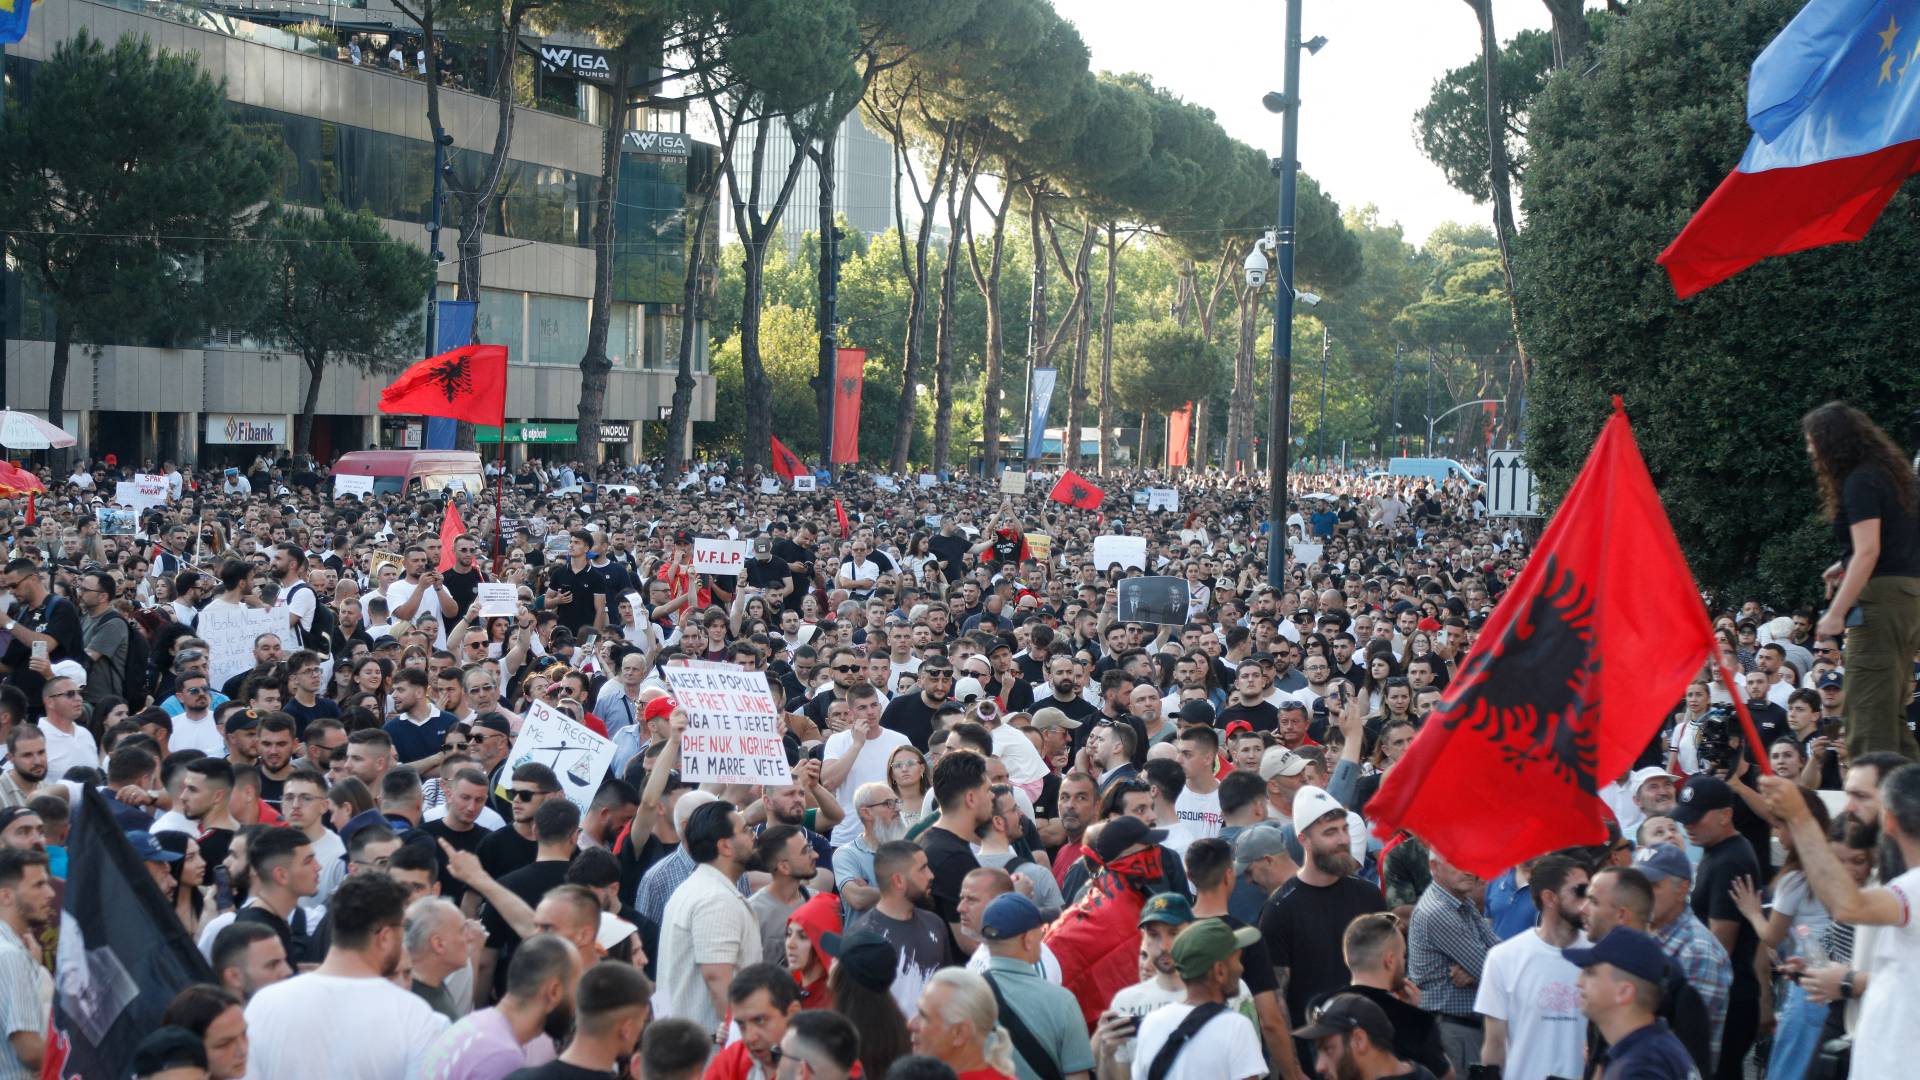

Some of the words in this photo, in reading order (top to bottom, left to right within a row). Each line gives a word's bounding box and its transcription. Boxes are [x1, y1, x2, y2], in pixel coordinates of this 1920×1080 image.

[573, 70, 610, 78] OUNGE
[238, 422, 273, 441] Fibank
[600, 425, 630, 436] VINOPOLY
[697, 550, 741, 564] V.F.L.P.
[667, 672, 705, 689] MJERE
[718, 673, 766, 693] POPULL
[697, 692, 728, 711] PRET
[732, 694, 774, 714] LIRINE
[687, 712, 710, 729] NGA
[713, 714, 731, 730] TE
[734, 715, 774, 732] TJERET
[526, 724, 545, 743] ME
[683, 735, 705, 752] DHE
[709, 735, 734, 753] NUK
[739, 735, 782, 757] NGRIHET
[683, 756, 699, 775] TA
[708, 756, 747, 776] MARRE
[753, 758, 785, 777] VETE
